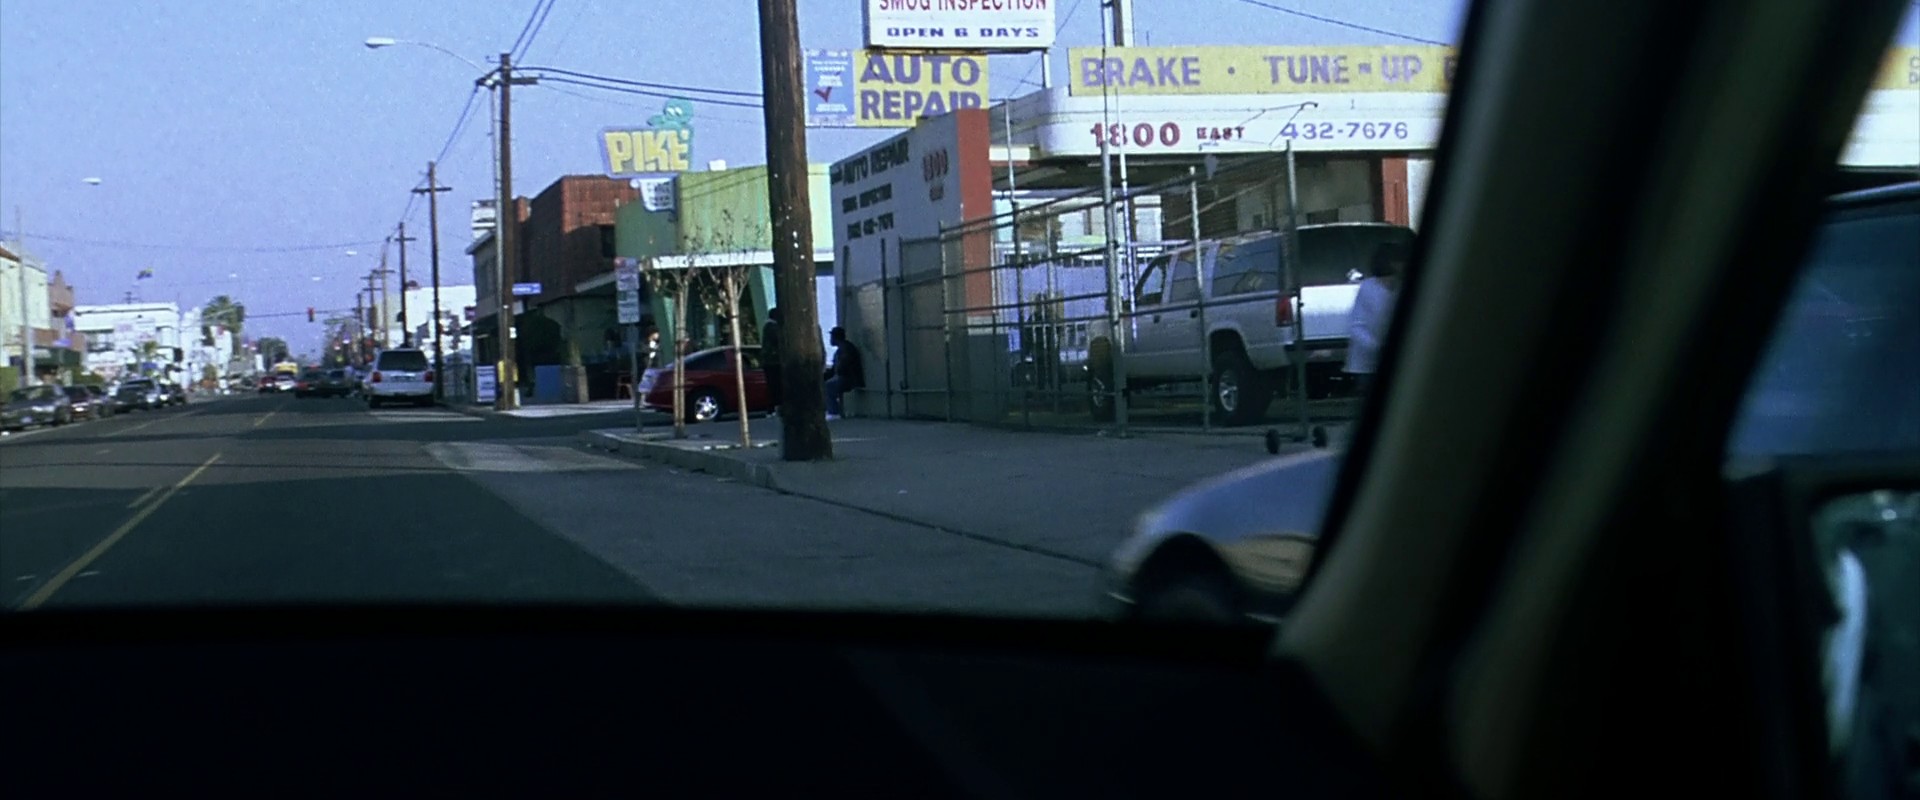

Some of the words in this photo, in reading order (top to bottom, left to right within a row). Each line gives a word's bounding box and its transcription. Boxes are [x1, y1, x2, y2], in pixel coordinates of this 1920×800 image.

[887, 28, 944, 37] OPEN
[955, 28, 969, 37] 6
[980, 28, 1039, 37] DAYS
[860, 53, 981, 86] AUTO
[1081, 56, 1201, 87] BRAKE
[1091, 122, 1181, 148] 1800
[1197, 126, 1245, 140] EAST
[1281, 121, 1409, 140] 432-7676
[604, 129, 689, 173] PIKE
